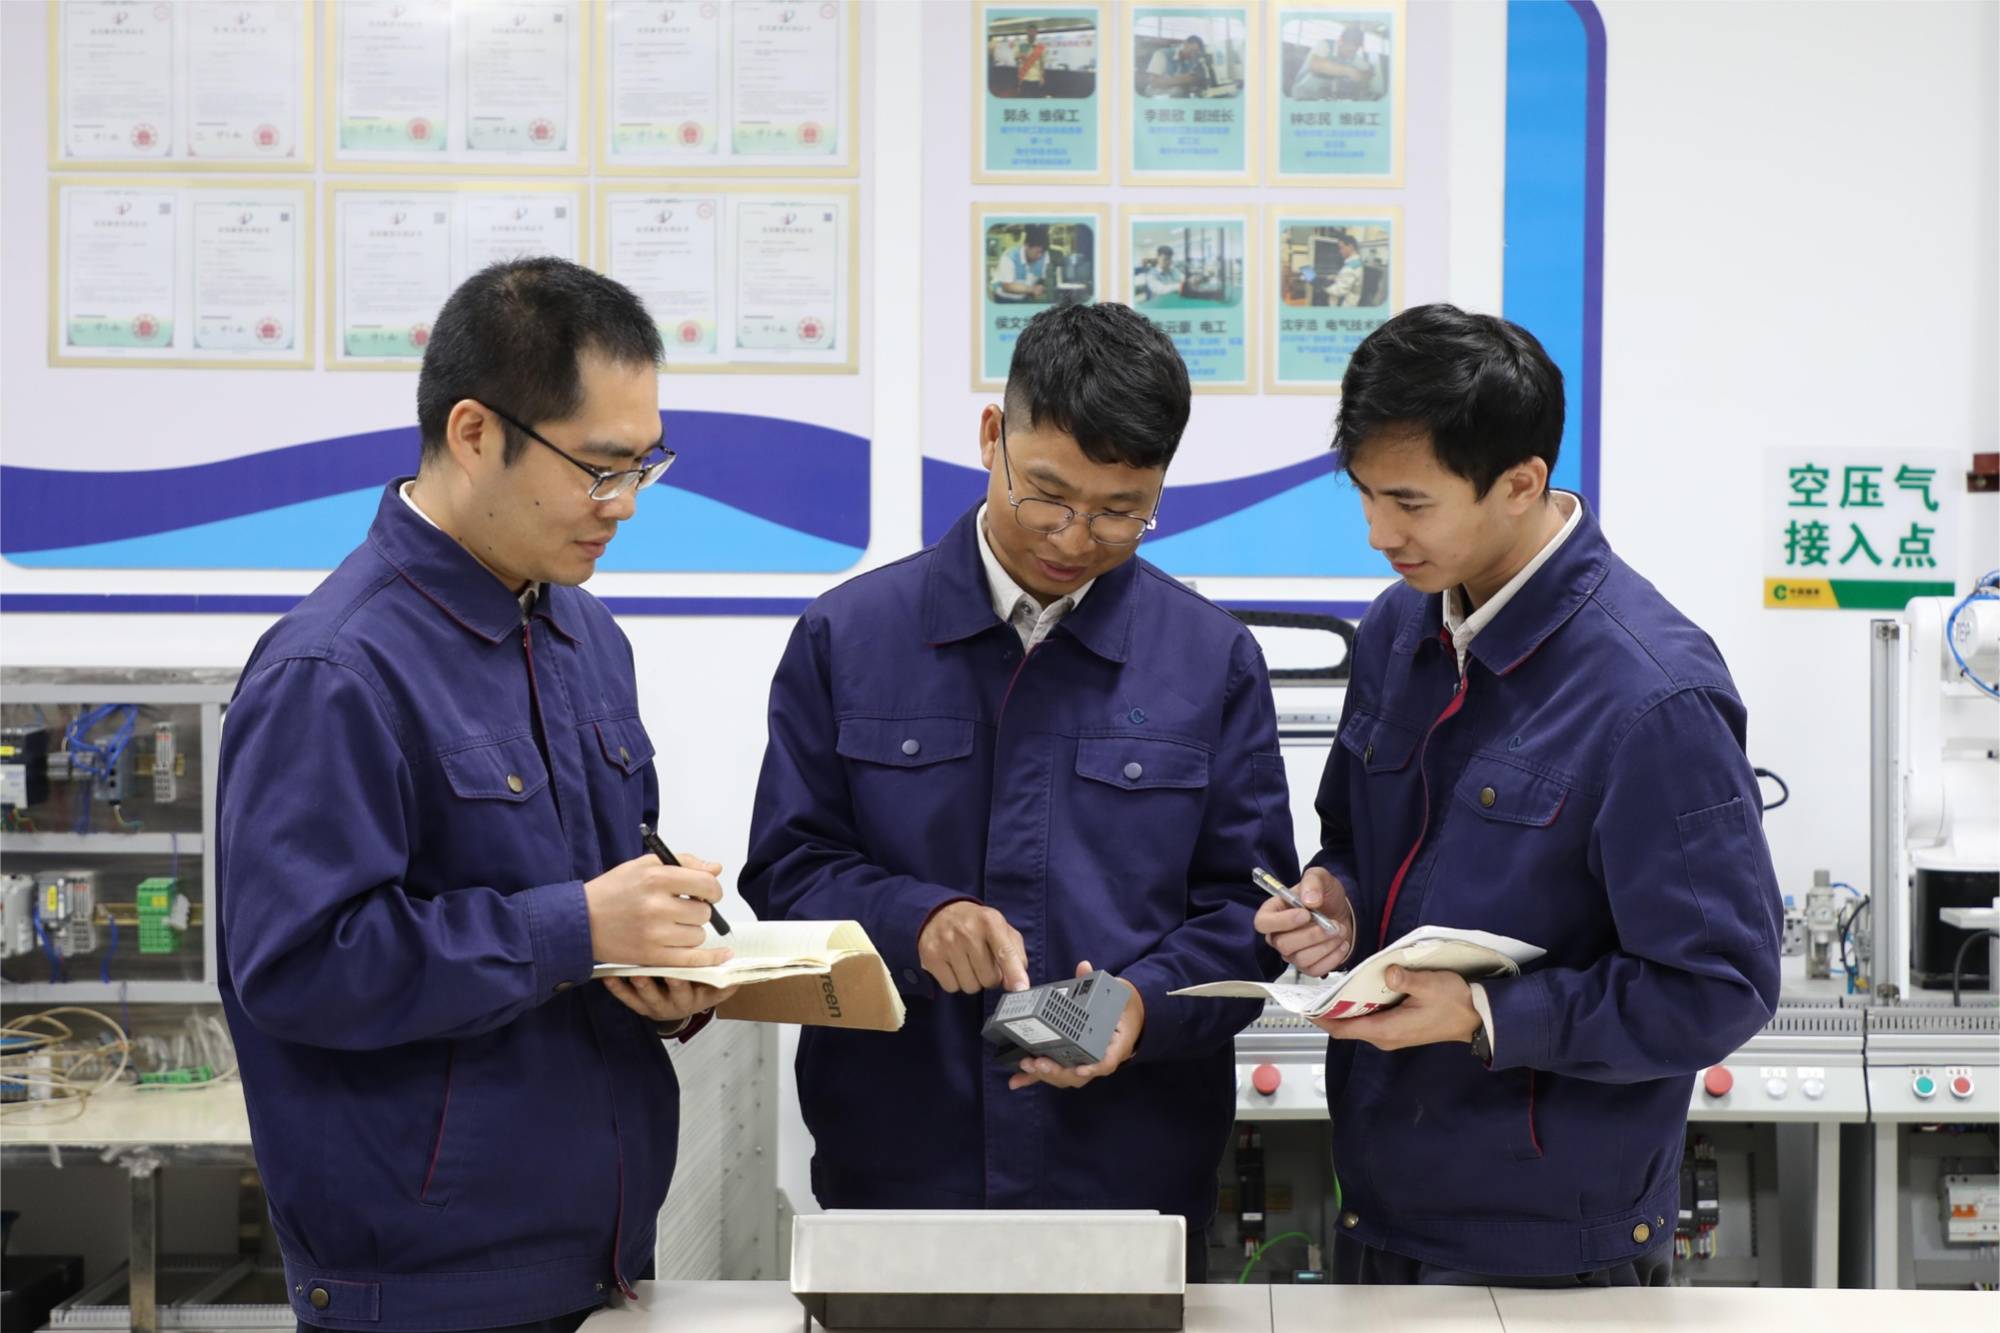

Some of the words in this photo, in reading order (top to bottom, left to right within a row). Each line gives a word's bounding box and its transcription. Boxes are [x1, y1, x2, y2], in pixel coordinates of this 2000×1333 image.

[1039, 109, 1081, 123] 维保工
[1339, 112, 1382, 126] 维保工
[1199, 320, 1227, 334] 电工
[1787, 463, 1940, 512] 空压气
[1784, 519, 1938, 569] 接入点
